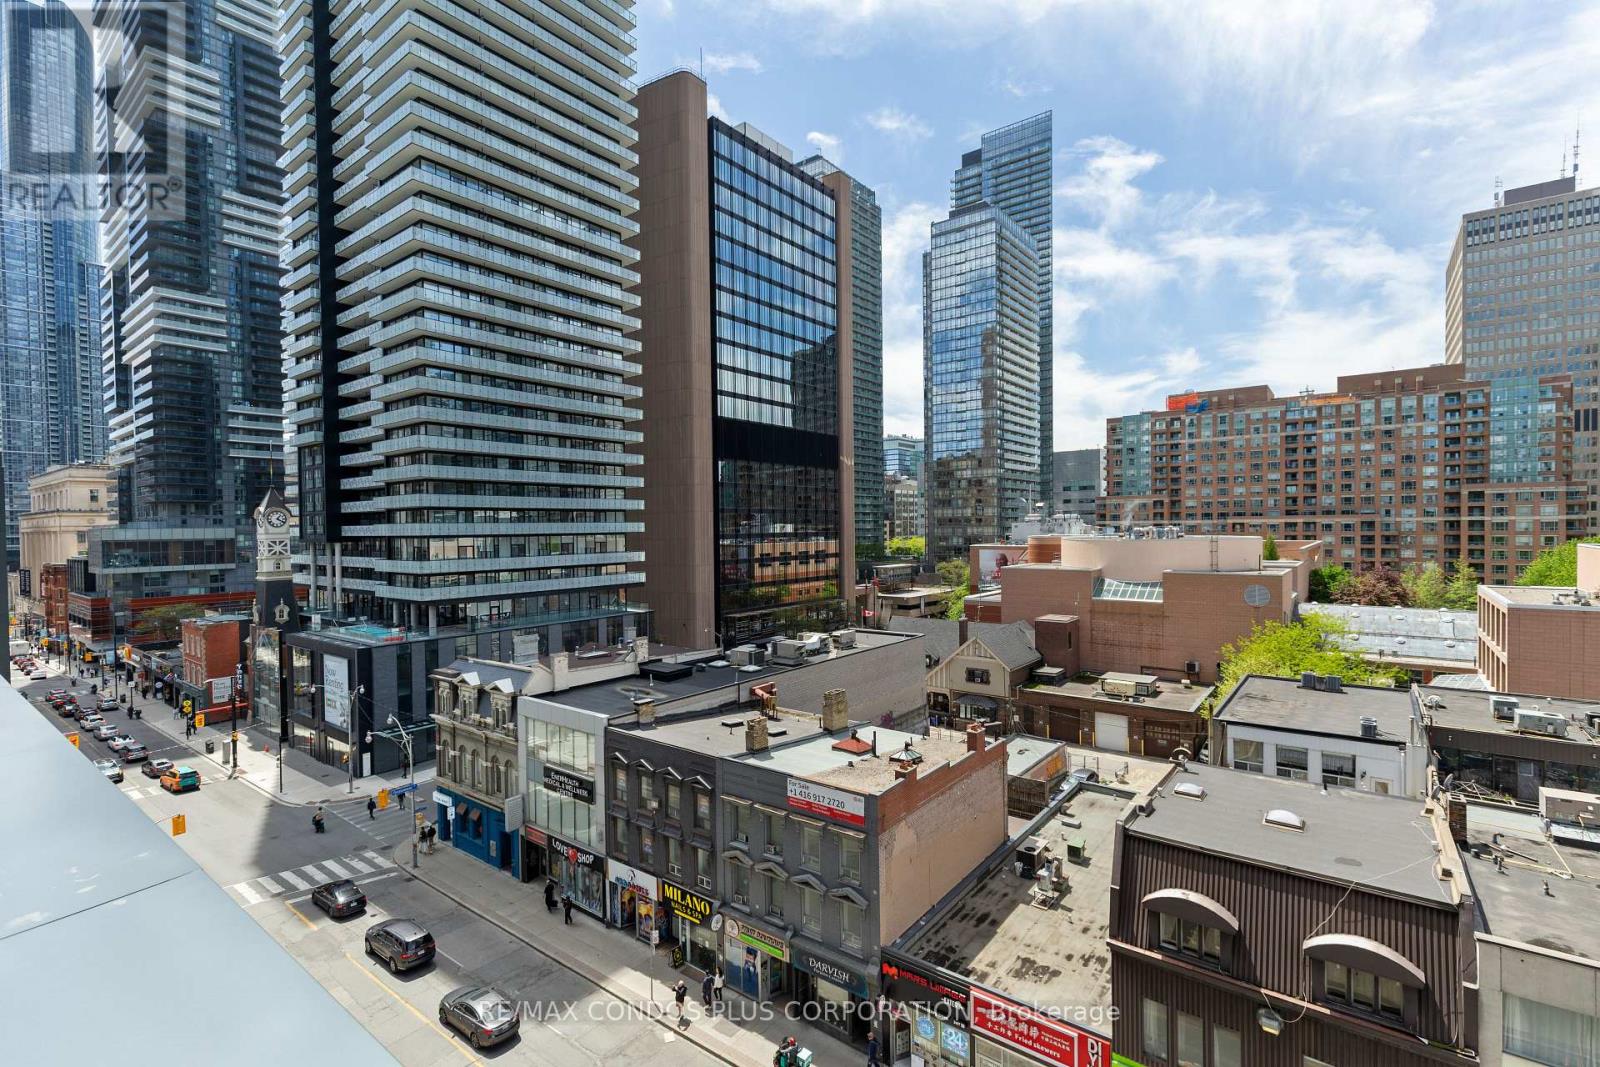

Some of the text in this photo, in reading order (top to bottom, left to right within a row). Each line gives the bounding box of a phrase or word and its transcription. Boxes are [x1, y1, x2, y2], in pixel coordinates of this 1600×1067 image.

[565, 783, 589, 797] WELLNESS
[798, 790, 812, 800] 416
[813, 793, 826, 803] 917
[827, 797, 845, 809] 2720
[552, 838, 568, 857] LOVE
[577, 853, 594, 864] SHOP
[664, 884, 710, 916] MILANO
[671, 901, 687, 913] NAILS
[692, 910, 702, 919] SPA
[809, 957, 849, 982] DARVISH
[1014, 1033, 1033, 1047] Fried
[1033, 1042, 1061, 1059] skewers
